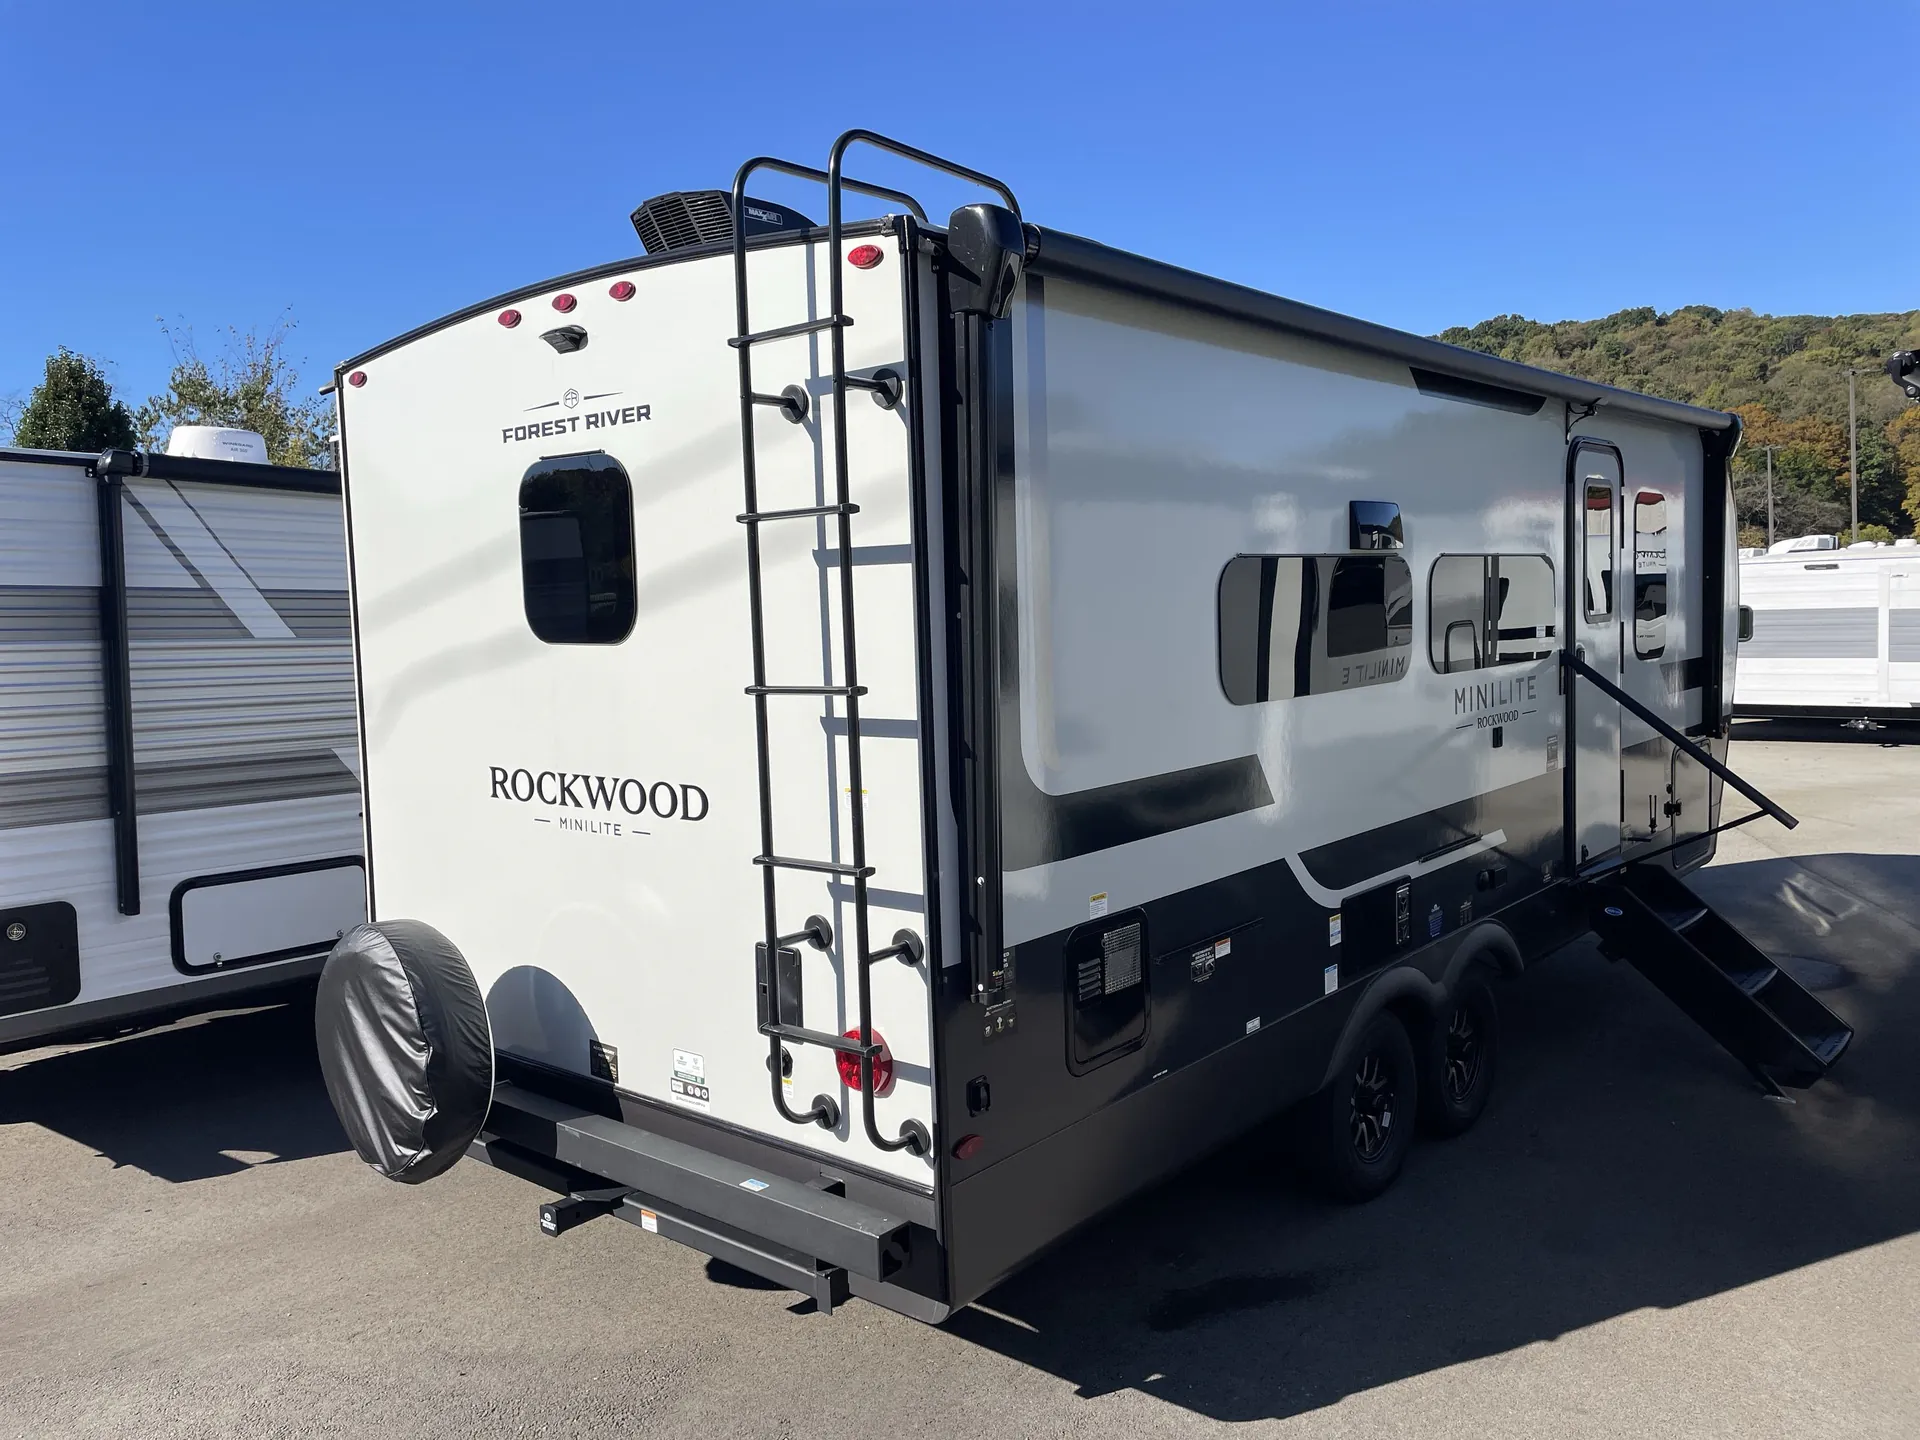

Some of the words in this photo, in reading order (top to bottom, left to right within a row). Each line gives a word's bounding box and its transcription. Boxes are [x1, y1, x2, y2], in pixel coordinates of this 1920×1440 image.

[501, 416, 580, 443] FOREST
[585, 404, 651, 430] RIVER
[1454, 675, 1537, 715] MINILITE
[1477, 709, 1519, 729] ROCKWOOD
[489, 766, 709, 821] ROCKWOOD
[559, 816, 622, 836] MINILITE
